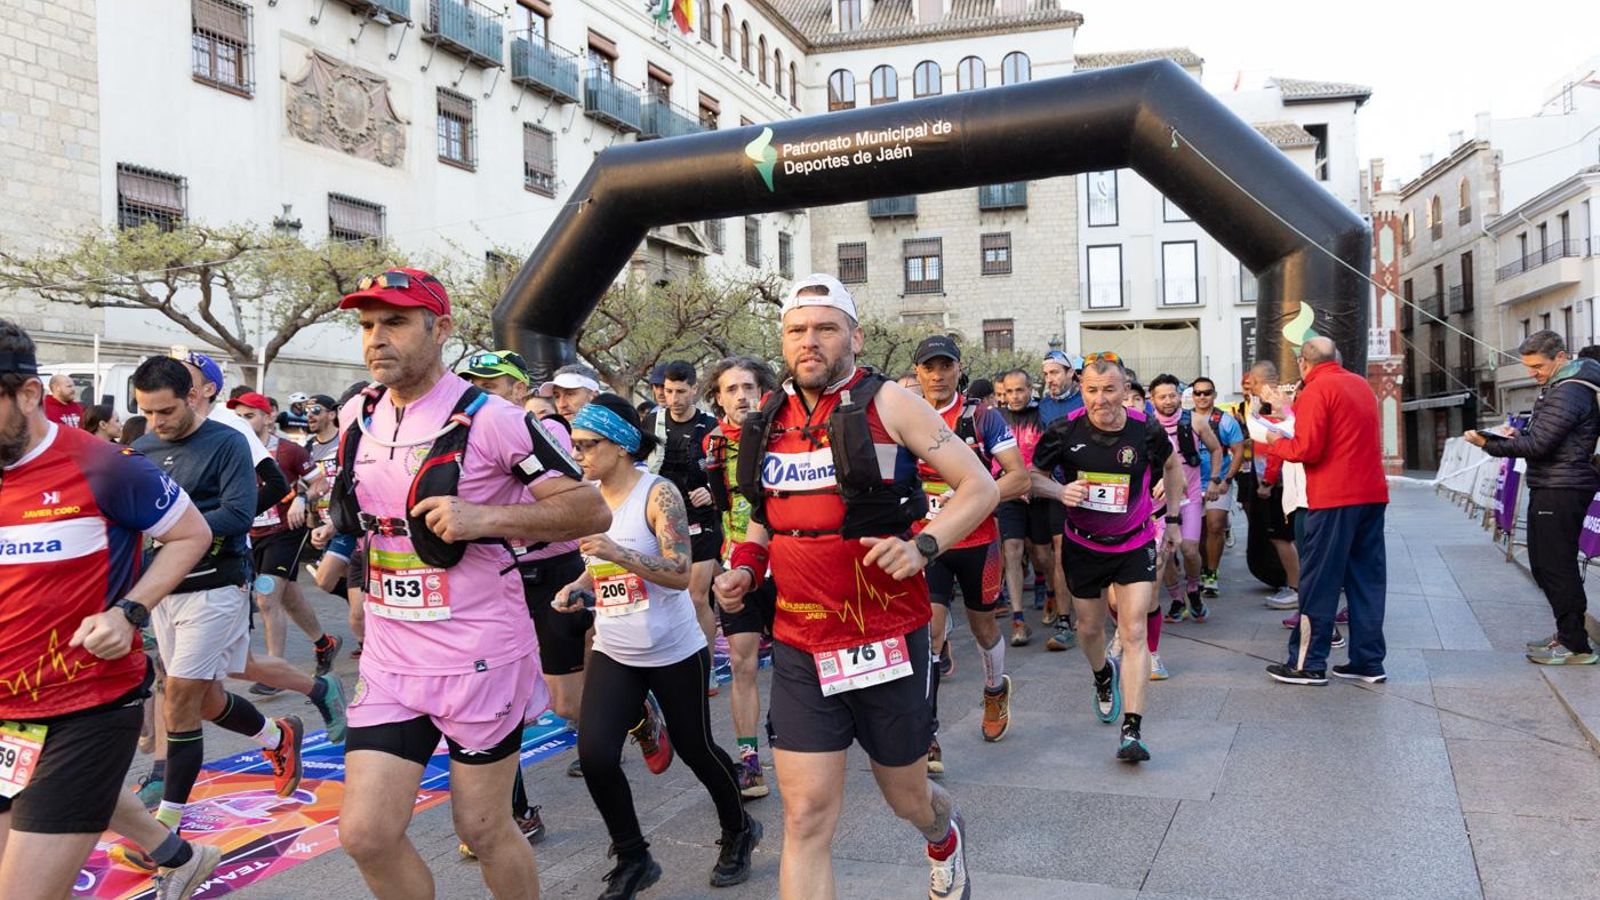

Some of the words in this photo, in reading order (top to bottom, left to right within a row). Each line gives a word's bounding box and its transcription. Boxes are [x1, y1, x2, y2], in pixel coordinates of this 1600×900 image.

[782, 136, 852, 157] Patronato
[855, 122, 928, 147] Municipal
[932, 120, 952, 135] de
[783, 155, 849, 176] Deportes
[853, 150, 873, 165] de
[876, 143, 913, 162] Jaén
[1098, 488, 1106, 498] 2
[22, 507, 53, 519] JAVIER
[384, 578, 422, 598] 153
[601, 582, 626, 599] 206
[847, 643, 877, 665] 76
